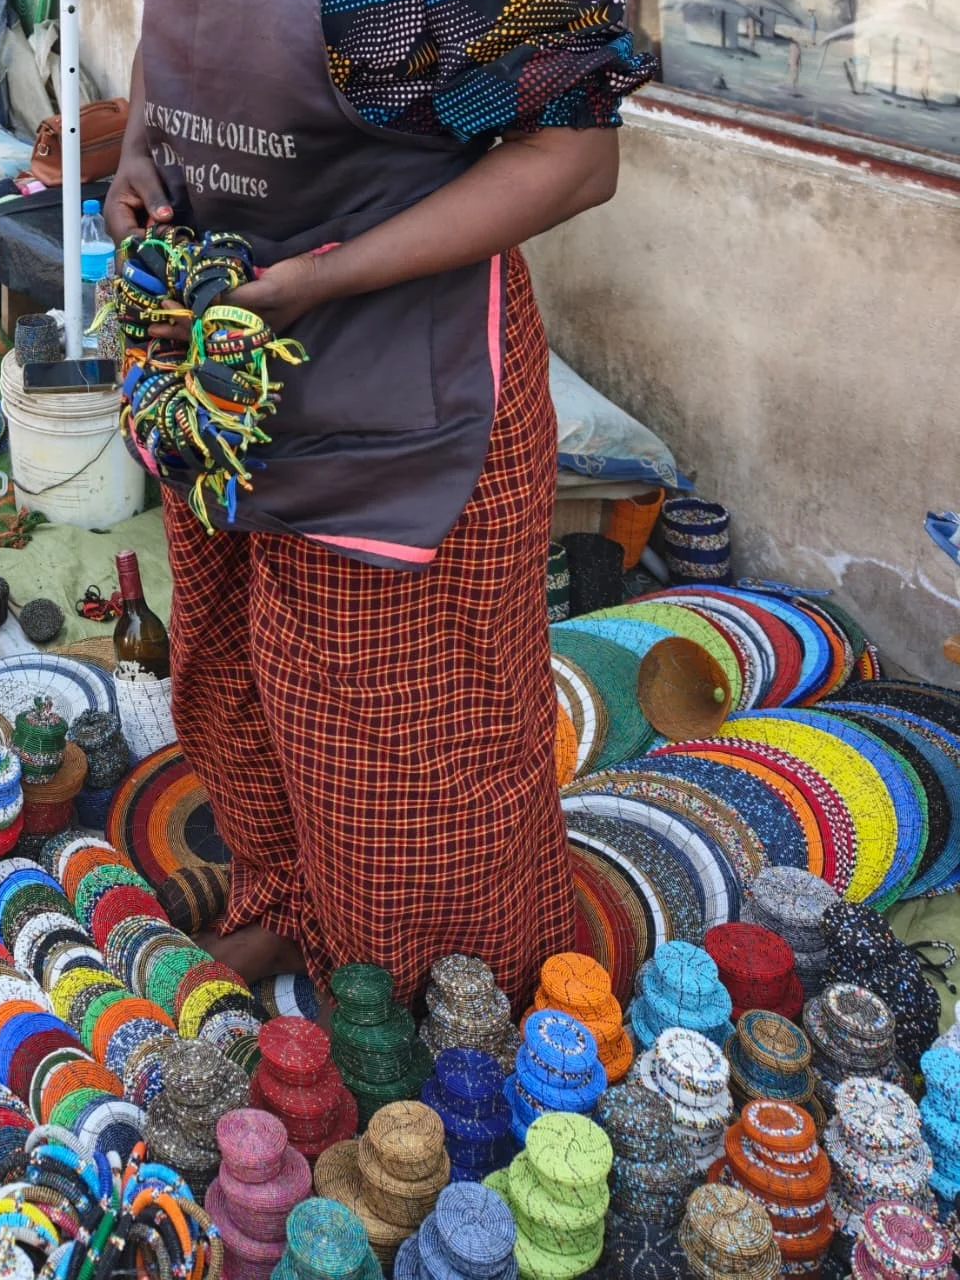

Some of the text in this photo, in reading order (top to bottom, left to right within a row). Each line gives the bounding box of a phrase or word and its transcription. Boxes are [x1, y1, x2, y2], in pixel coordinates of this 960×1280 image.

[157, 105, 213, 144] SYSTEM
[217, 121, 297, 159] COLLEGE
[209, 163, 269, 199] Course
